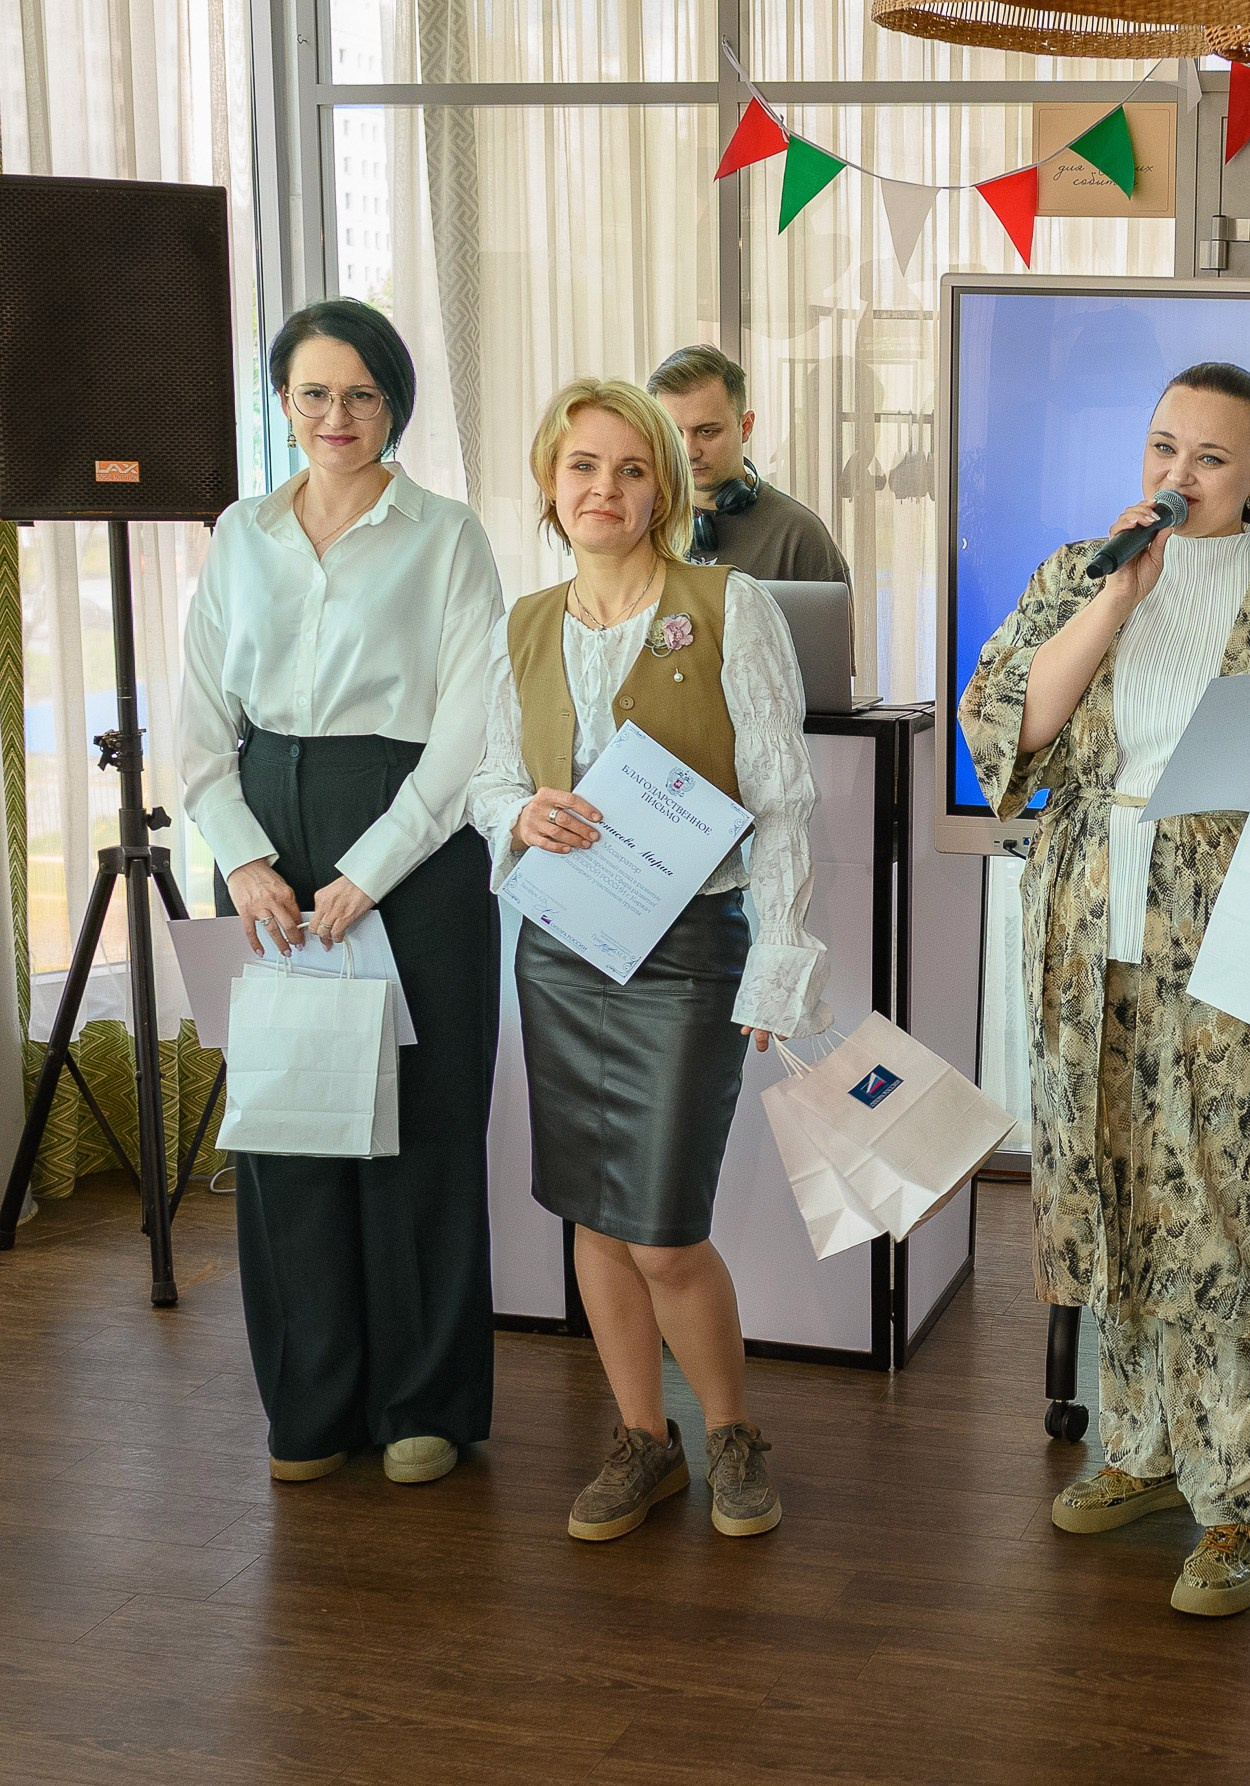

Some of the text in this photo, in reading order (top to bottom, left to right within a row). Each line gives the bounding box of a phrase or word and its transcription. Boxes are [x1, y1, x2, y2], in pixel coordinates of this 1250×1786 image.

[95, 461, 139, 474] LAX
[621, 763, 712, 836] БЛАГОДАРСТВЕННОЕ
[640, 791, 680, 824] ПИСЬМО
[599, 819, 674, 877] енисова Мария
[601, 841, 642, 874] Модератор
